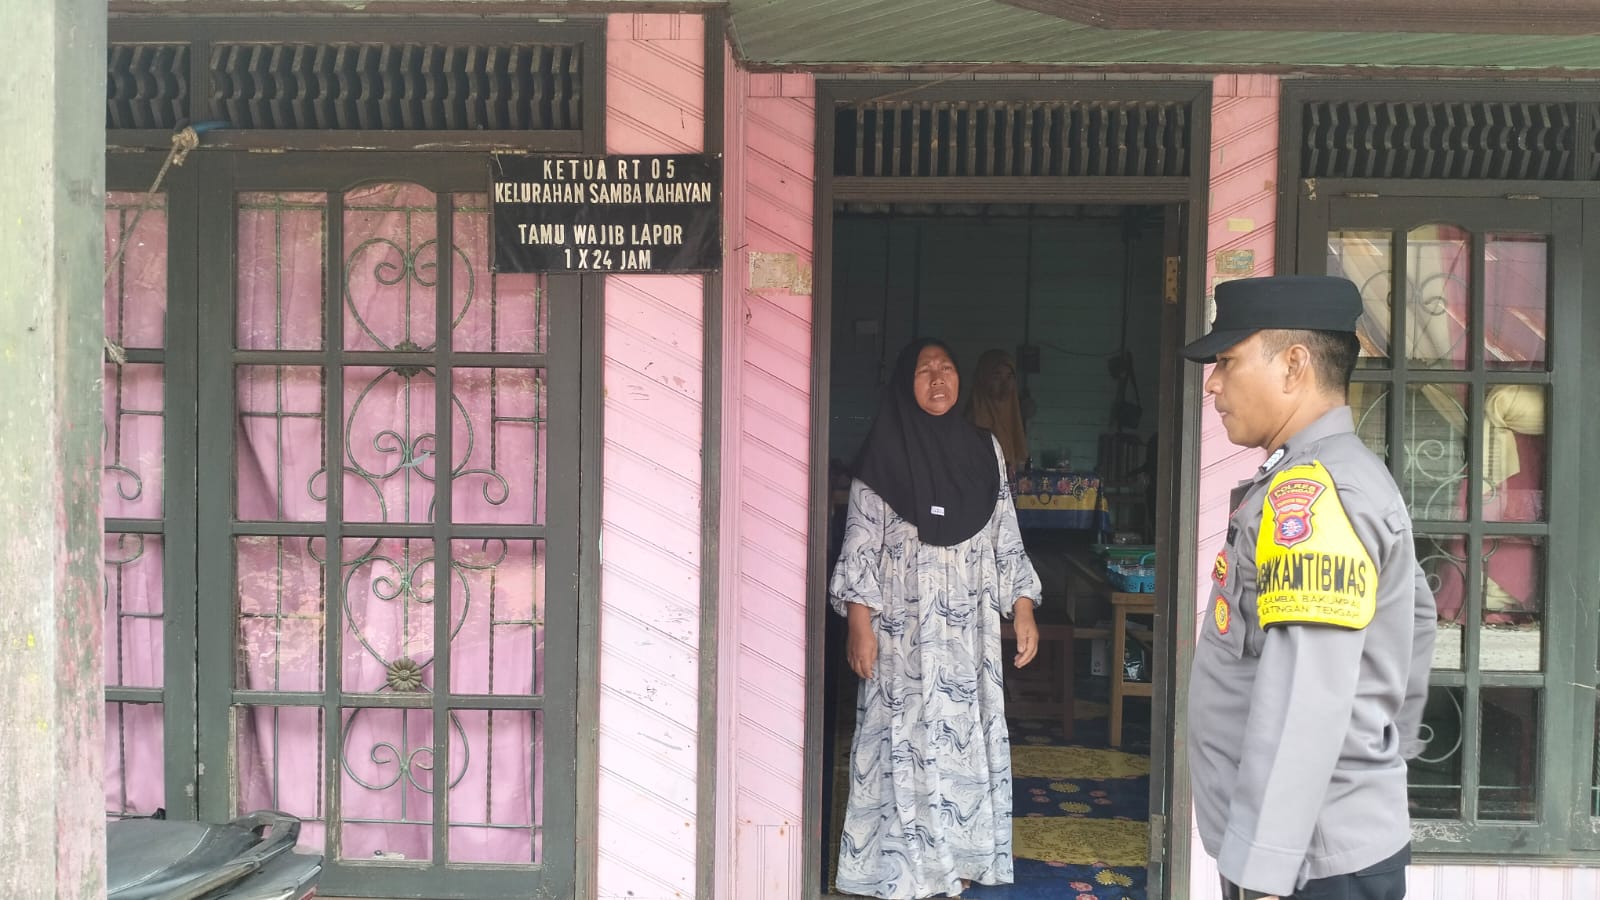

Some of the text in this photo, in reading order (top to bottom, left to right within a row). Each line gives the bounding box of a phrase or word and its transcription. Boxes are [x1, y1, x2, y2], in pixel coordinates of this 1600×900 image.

[543, 159, 607, 180] KETUA
[618, 159, 641, 180] RT
[494, 182, 712, 204] KELURAHAN SAMBA KAHAYAN
[518, 223, 683, 245] TAMU WAJIB LAPOR
[564, 248, 572, 269] 1
[620, 249, 651, 270] JAM
